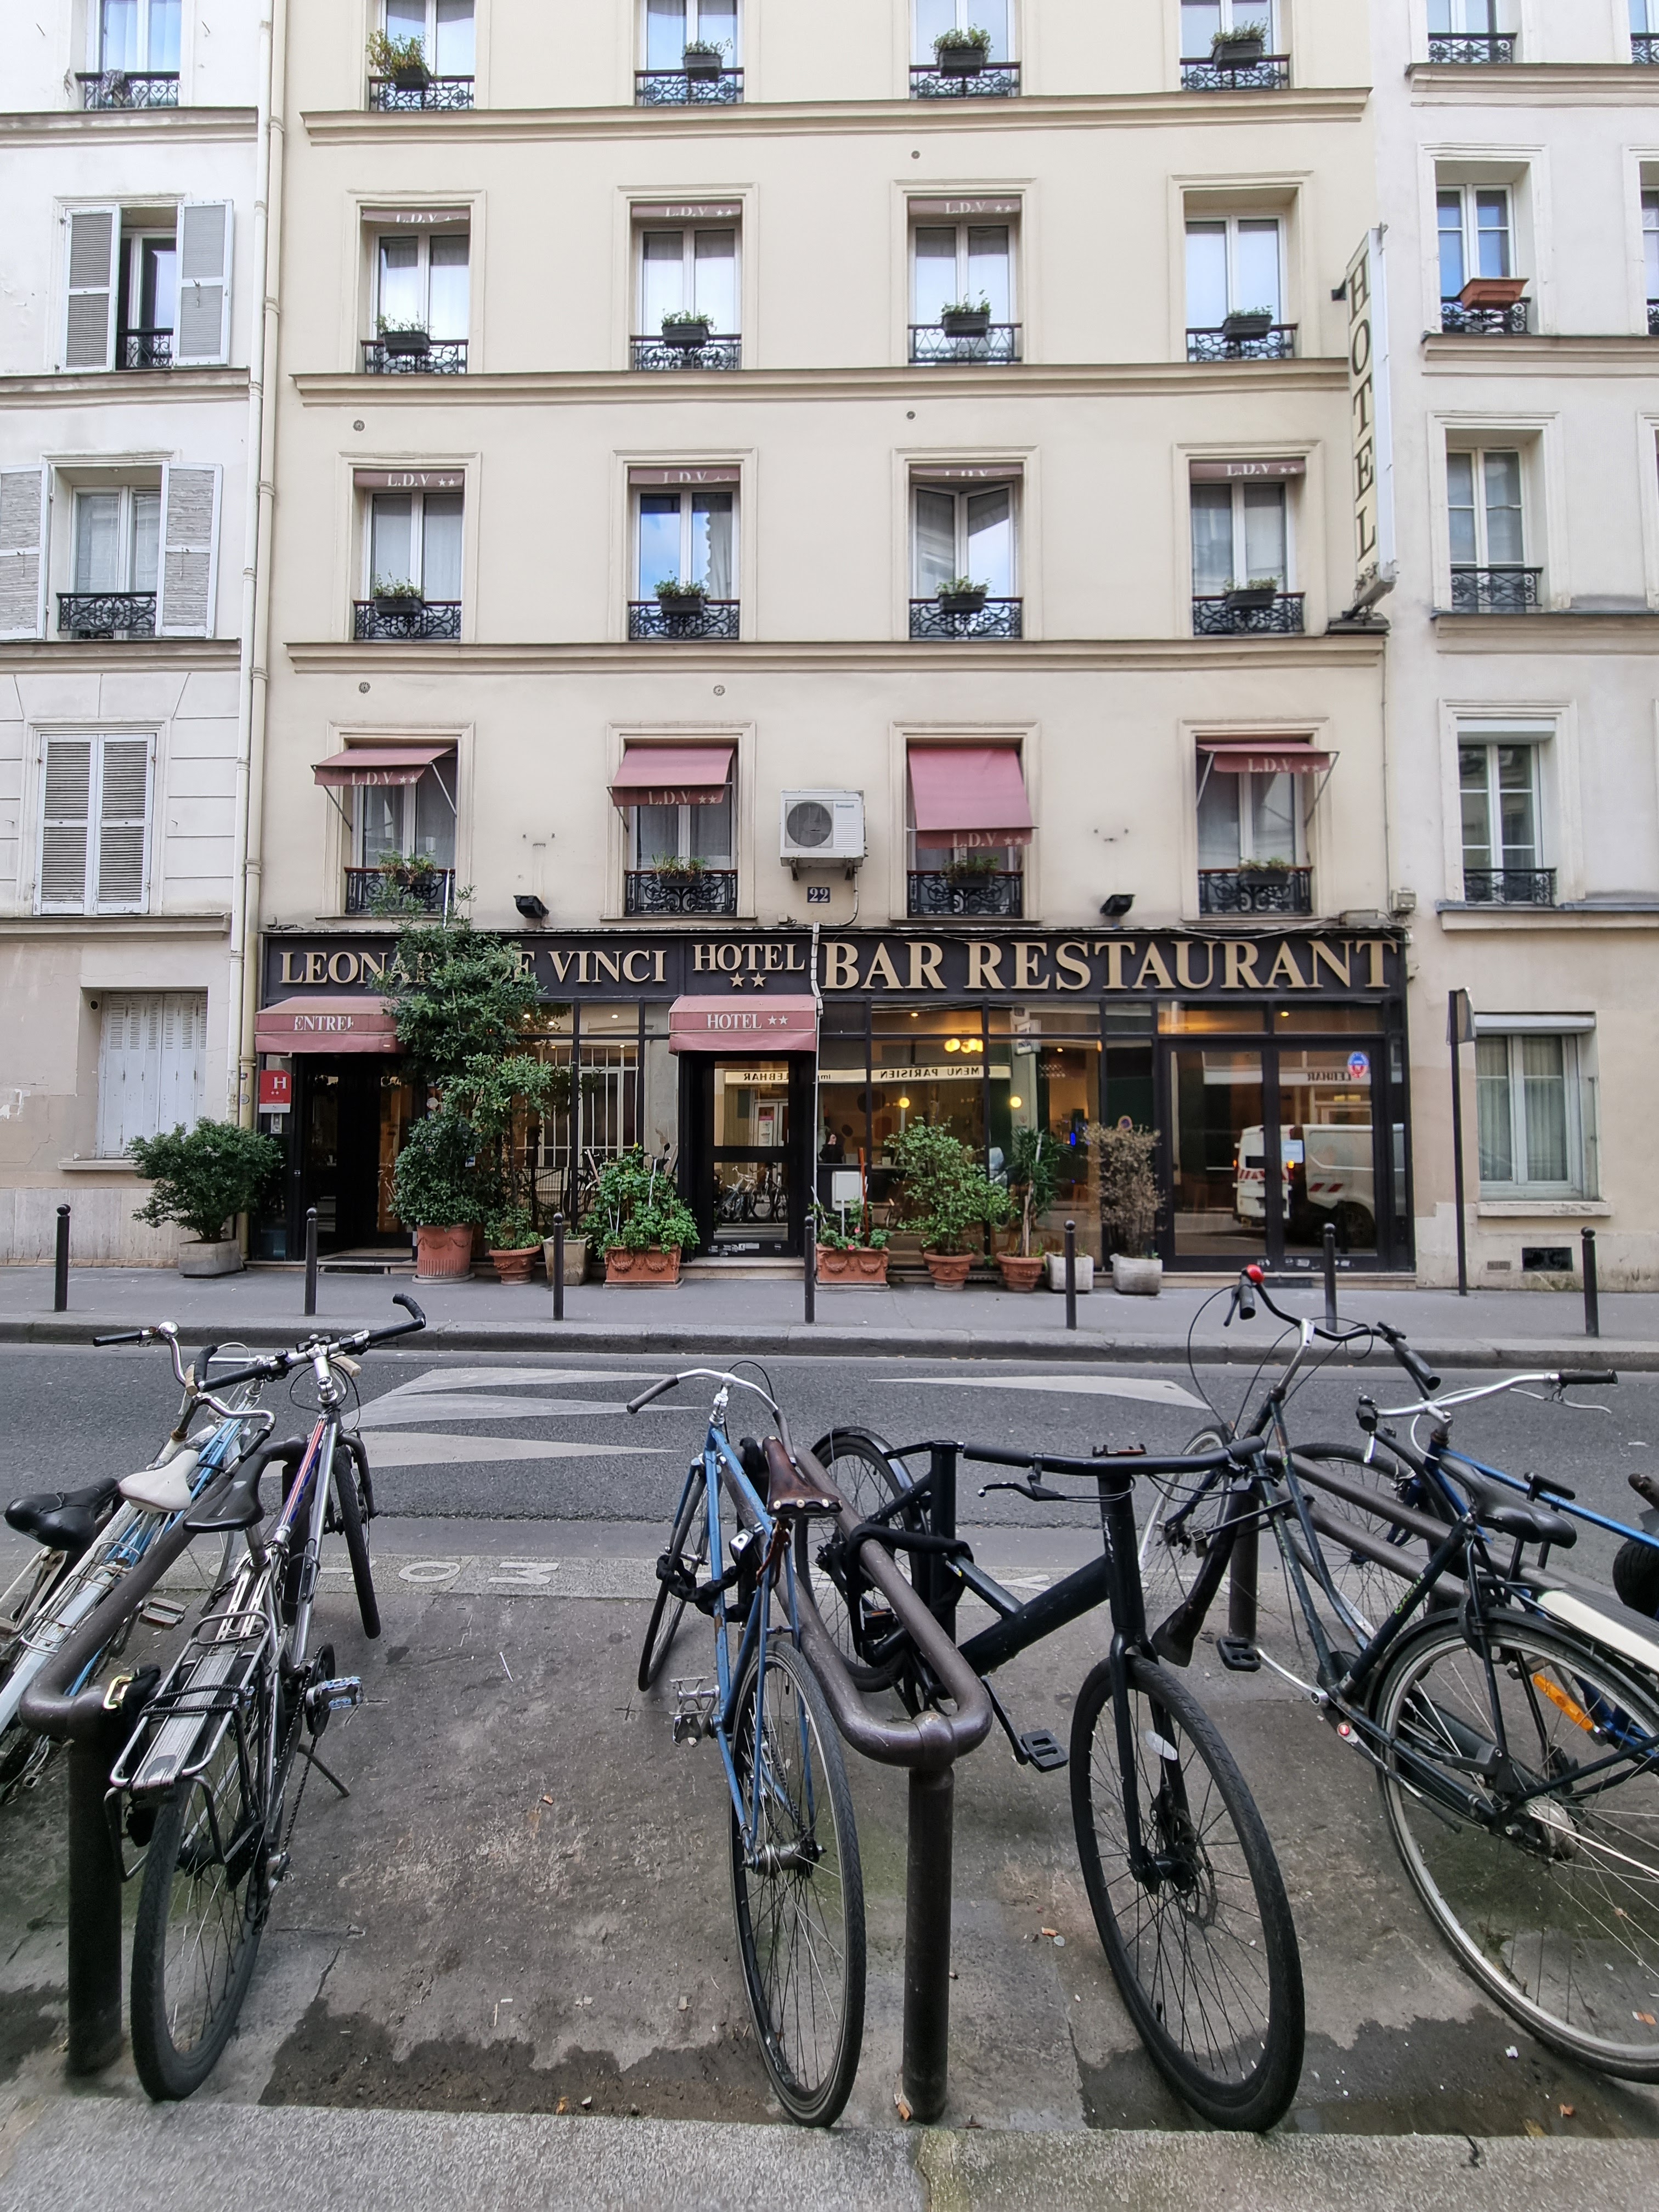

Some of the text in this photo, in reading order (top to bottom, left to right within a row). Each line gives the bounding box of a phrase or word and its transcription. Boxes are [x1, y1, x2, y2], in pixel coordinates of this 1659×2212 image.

[1348, 249, 1376, 562] HOTEL
[1226, 464, 1270, 476] L.D.V
[386, 473, 431, 487] L.D.V
[1248, 758, 1293, 772] L.D.V
[351, 771, 393, 786] L.D.V
[648, 791, 690, 805] L.D.V
[952, 832, 997, 847] L.D.V
[809, 888, 828, 902] 22
[692, 944, 805, 971] HOTEL
[821, 939, 1397, 990] BAR RESTAURANT
[279, 951, 475, 983] LEONAR
[548, 949, 667, 983] VINCI
[707, 1014, 762, 1030] HOTEL
[273, 1076, 287, 1089] H
